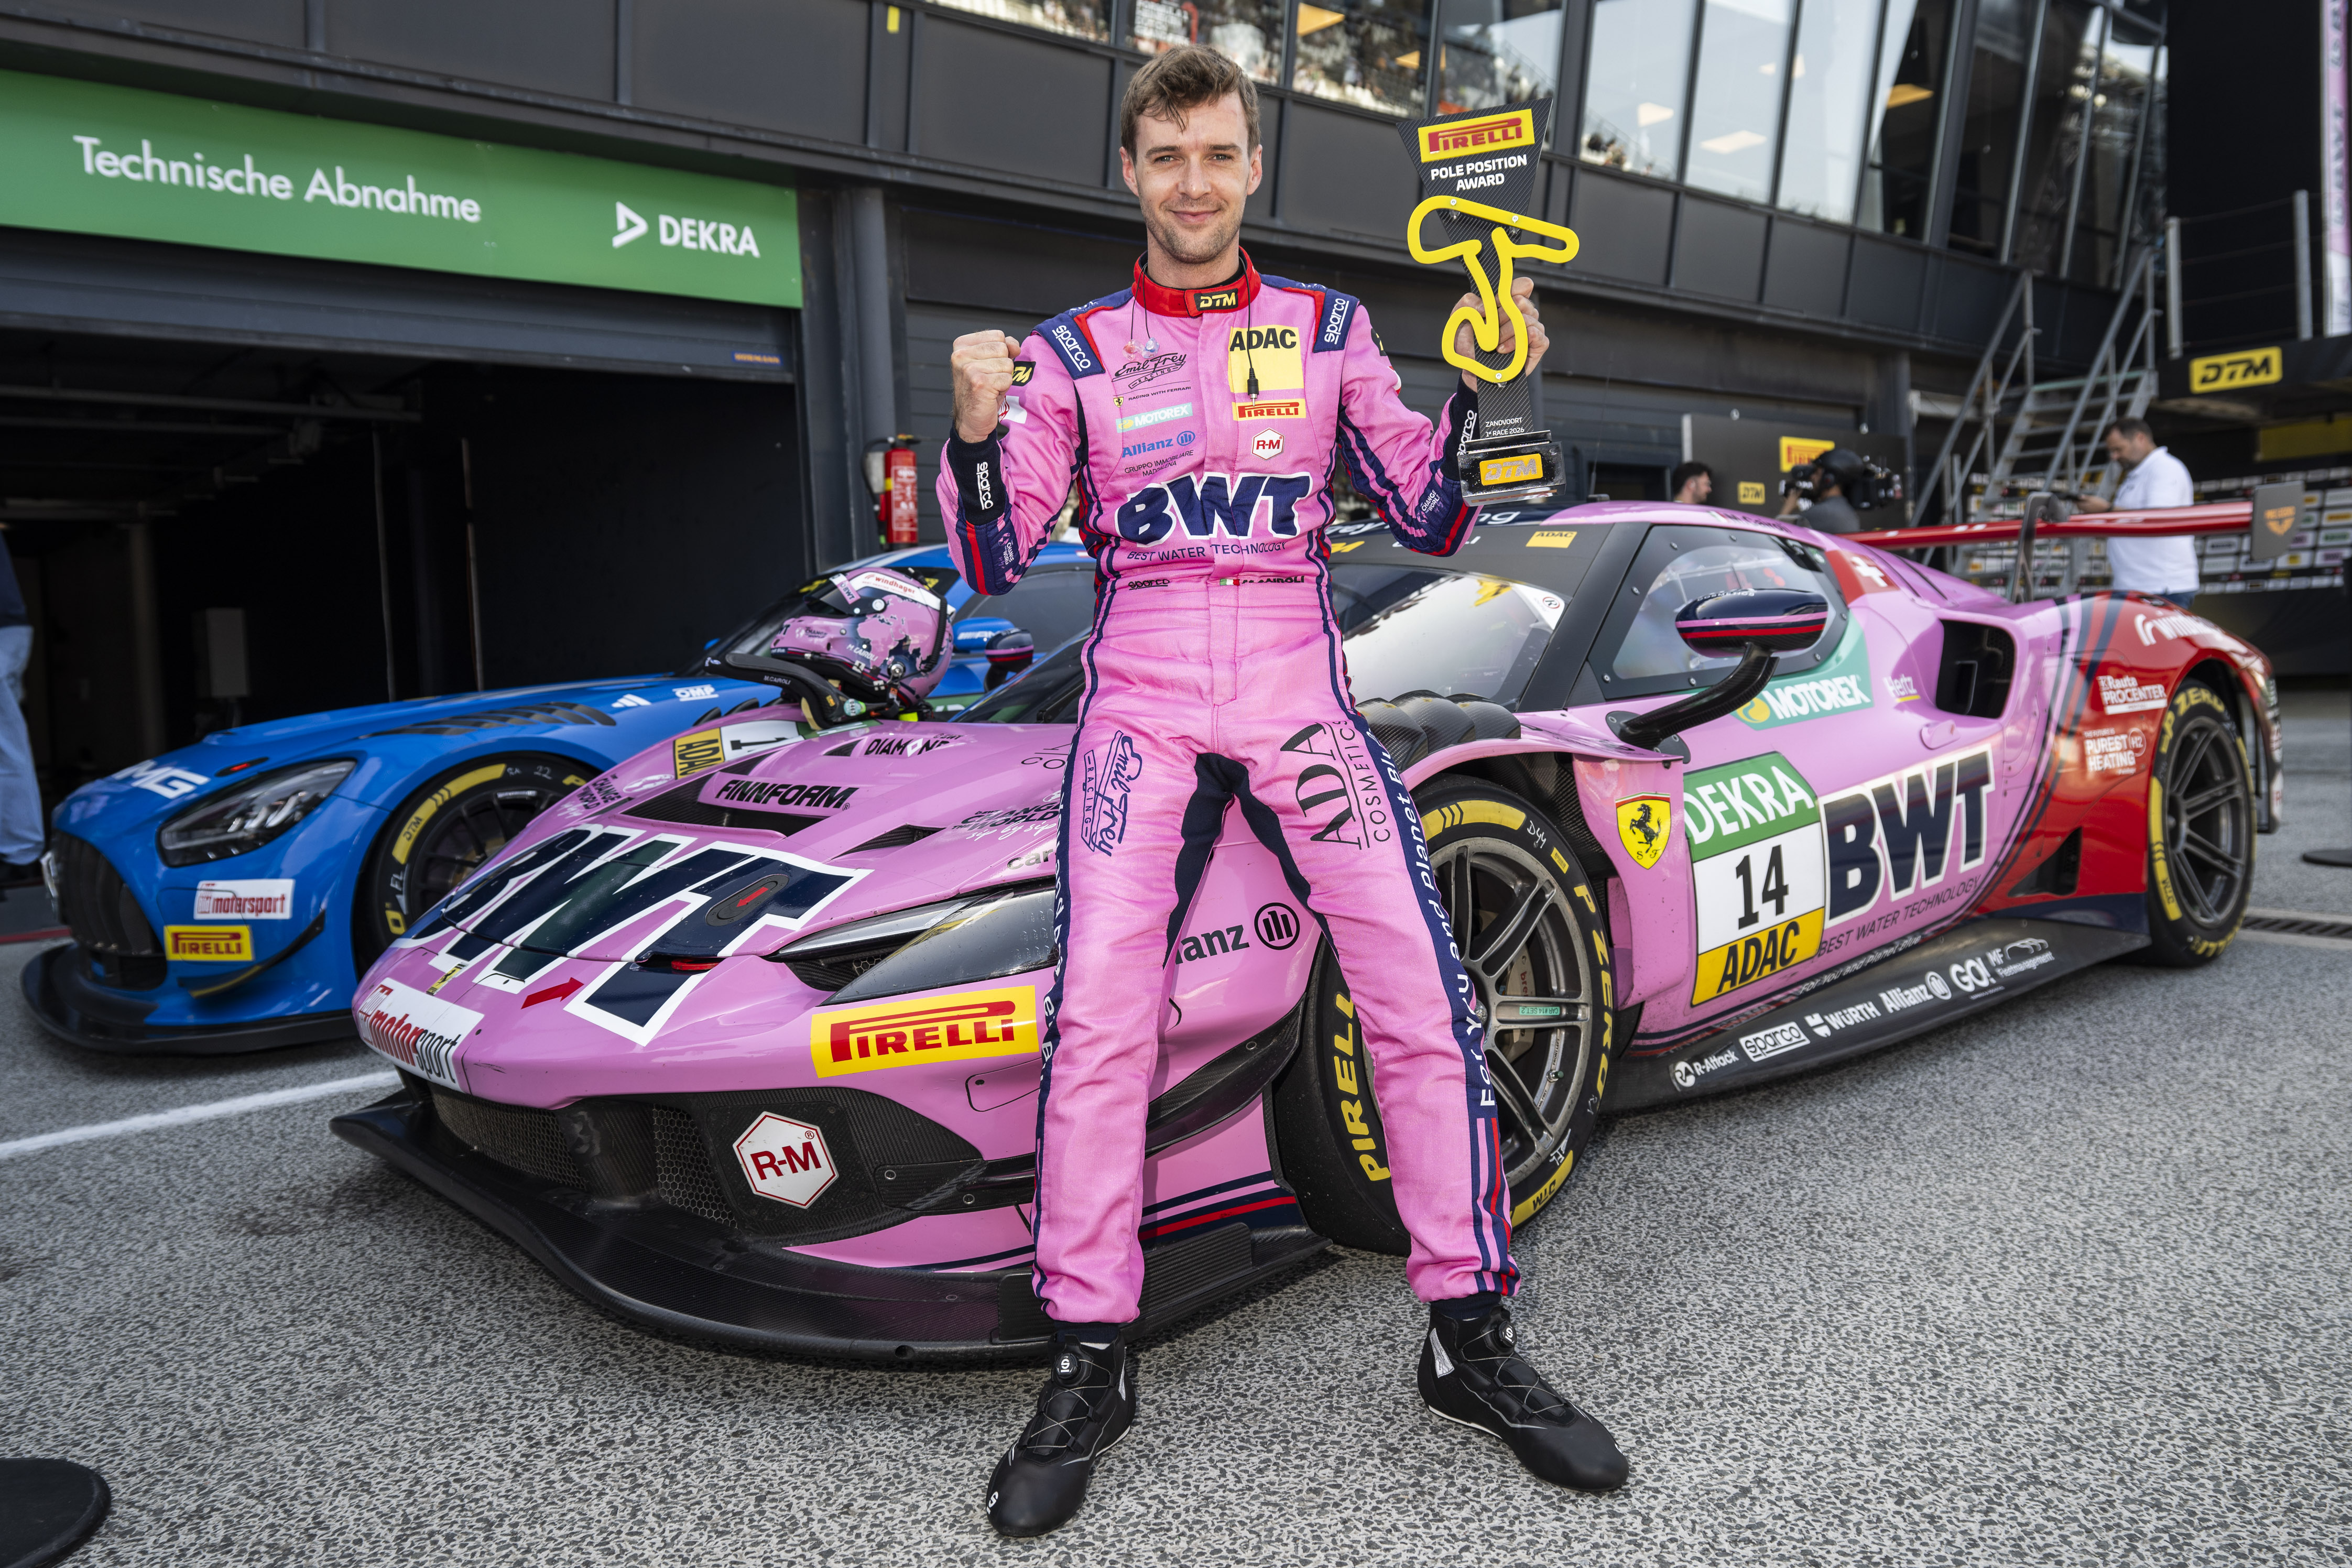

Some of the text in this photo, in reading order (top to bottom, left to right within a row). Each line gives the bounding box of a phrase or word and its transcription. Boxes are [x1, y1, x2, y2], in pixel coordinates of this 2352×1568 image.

[1428, 116, 1522, 154] PIRELLI
[72, 134, 482, 223] Technische Abnahme
[1431, 154, 1527, 180] POLE POSITION
[1456, 173, 1505, 191] AWARD
[658, 214, 760, 258] DEKRA
[1200, 292, 1236, 308] DTM
[1324, 298, 1346, 343] sparco
[1055, 325, 1091, 369] sparco
[1230, 328, 1297, 351] ADAC
[1012, 366, 1032, 383] TM
[1115, 353, 1187, 377] Emil Frey
[1138, 368, 1172, 384] RACING
[2201, 356, 2272, 384] DTM
[1135, 405, 1189, 427] MOTOREX
[1238, 402, 1299, 418] PIRELLI
[1485, 417, 1522, 427] ZANDVOORT
[1122, 439, 1174, 458] Allianz
[1124, 450, 1194, 474] GRUPPO IMMOBILIARE
[1485, 459, 1538, 481] DTM
[976, 462, 994, 510] sparco
[1117, 472, 1313, 547] BWT
[1422, 489, 1436, 511] CHANGE
[1127, 541, 1288, 561] BEST WATER TECHNOLOGY
[843, 586, 855, 601] BWT
[875, 576, 915, 594] windhager
[1128, 579, 1170, 590] sparco
[853, 647, 878, 661] CAIROLI
[675, 685, 715, 698] OMP
[1883, 673, 1918, 697] Hertz
[2103, 684, 2168, 705] PROCENTER
[2107, 675, 2138, 689] Rauta
[1762, 674, 1871, 720] MOTOREX
[2174, 686, 2225, 716] ZERO
[2084, 734, 2128, 756] PUREST
[2086, 750, 2136, 772] HEATING
[715, 779, 859, 809] FINNFORM
[1084, 766, 1094, 824] RACING
[1091, 736, 1143, 857] Emil Frey
[1280, 722, 1362, 850] ADA
[1684, 765, 1813, 844] DEKRA
[403, 816, 423, 842] DTM
[967, 811, 1059, 831] WORLD
[998, 819, 1026, 840] by
[1397, 792, 1435, 891] Planet
[1819, 744, 1995, 930] BWT
[1636, 847, 1660, 860] S F
[1735, 845, 1790, 930] 14
[212, 894, 285, 917] motorsport
[1817, 874, 1982, 958] BEST WATER TECHNOLOGY
[172, 932, 242, 954] PIRELLI
[396, 823, 875, 1047] BWT
[1429, 899, 1461, 961] and
[1716, 920, 1801, 994] ADAC
[1800, 980, 1819, 995] For
[1822, 970, 1841, 985] You
[1843, 956, 1867, 975] and
[1864, 945, 1899, 966] Planet
[1986, 948, 2004, 967] MF
[1949, 956, 1997, 992] GO!
[1879, 983, 1934, 1014] Allianz
[1592, 929, 1614, 1103] ZERO
[1824, 1000, 1881, 1031] WÜRTH
[831, 1000, 1016, 1063] PIRELLI
[1745, 1026, 1802, 1057] sparco
[369, 1009, 462, 1084] motorsport
[1692, 1049, 1739, 1076] R-Attack
[1334, 994, 1391, 1182] PIRELL
[1532, 1179, 1556, 1212] DTM
